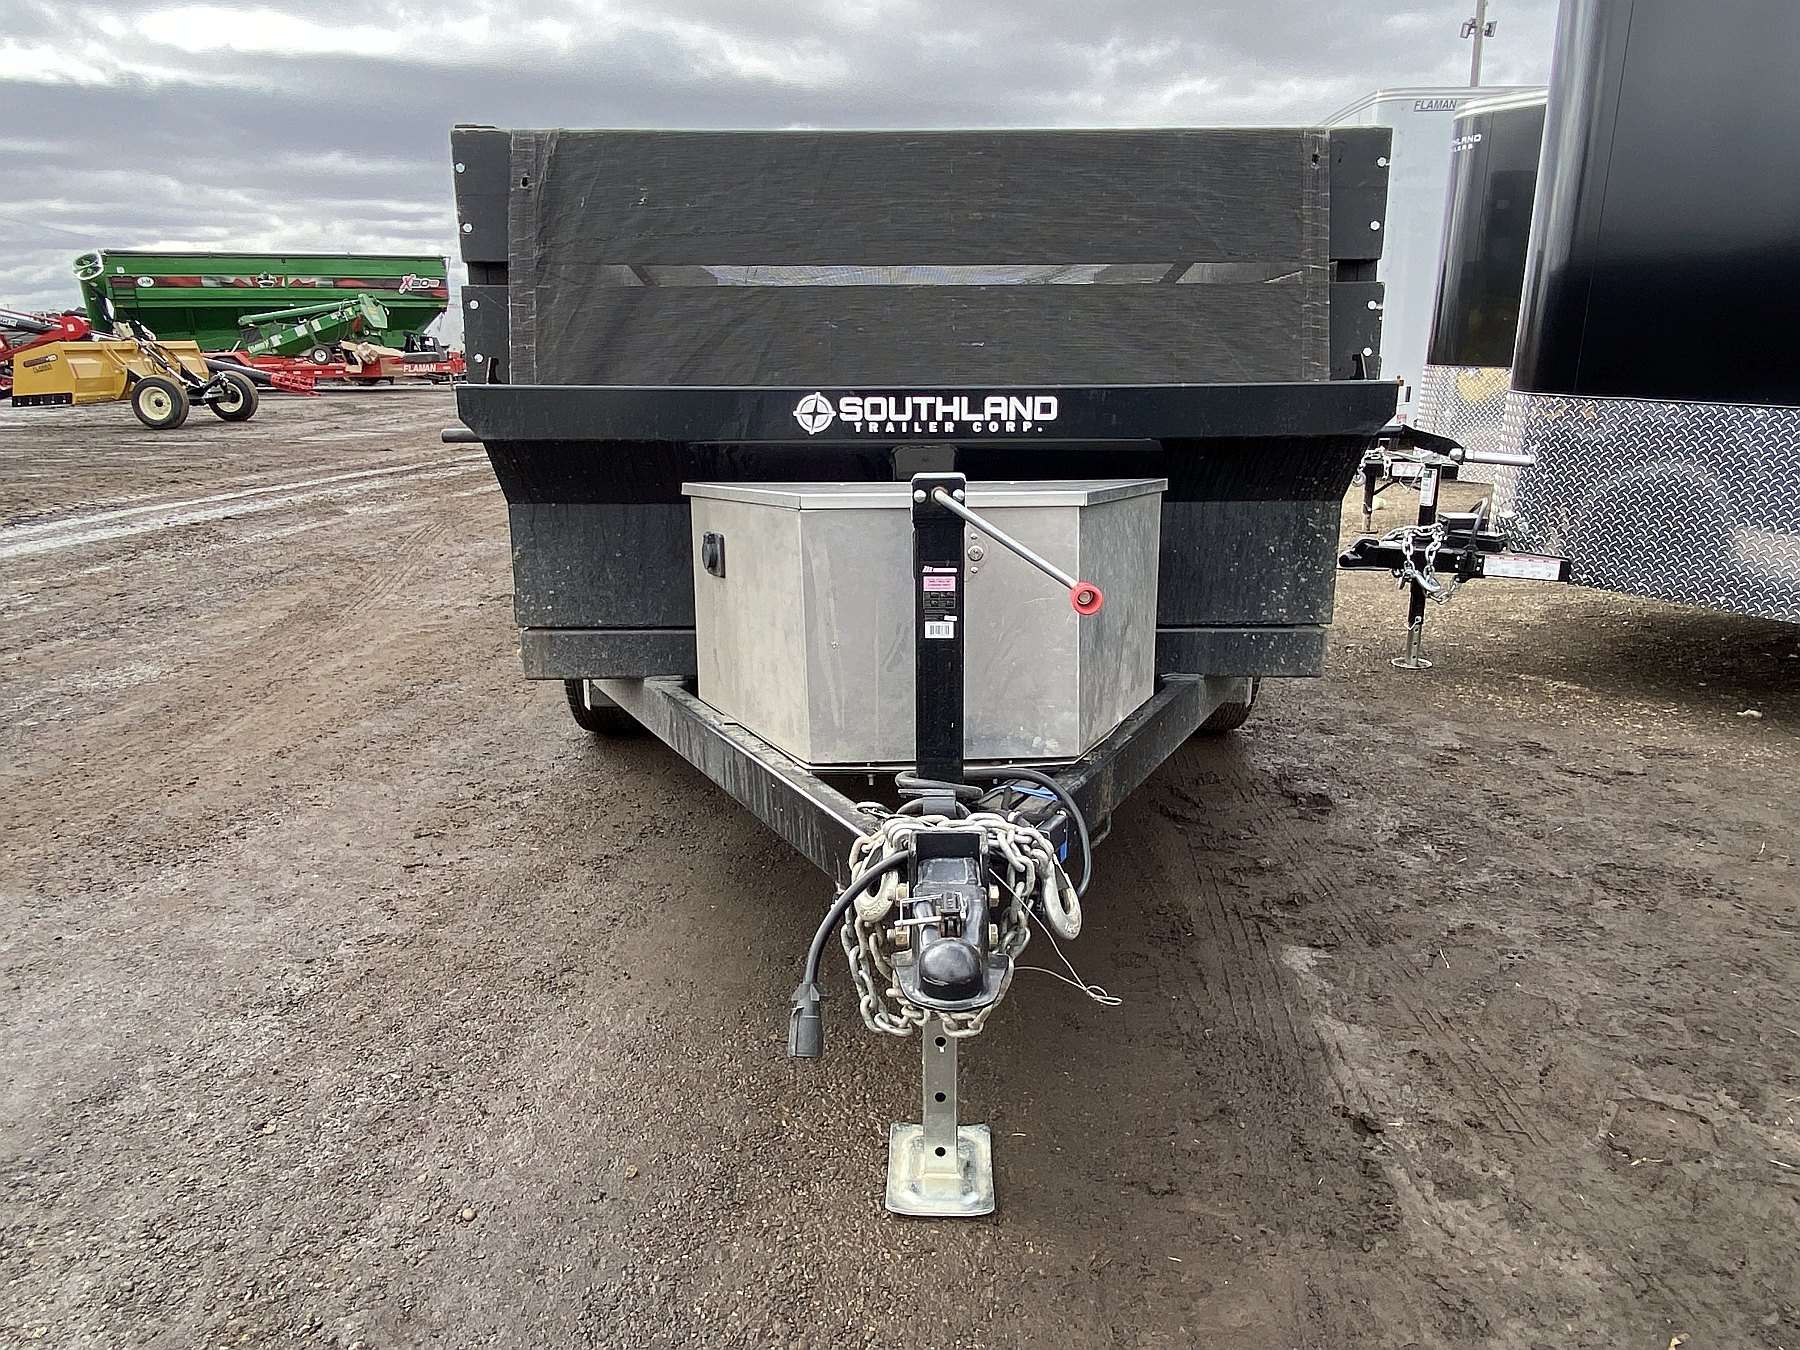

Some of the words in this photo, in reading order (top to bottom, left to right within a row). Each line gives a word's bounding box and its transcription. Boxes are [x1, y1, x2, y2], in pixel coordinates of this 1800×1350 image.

[1414, 100, 1456, 111] FLAMAN
[403, 363, 437, 373] FLAMAN
[839, 396, 1058, 422] SOUTHLAND
[854, 421, 955, 433] TRAILER
[972, 421, 1044, 433] CORP.
